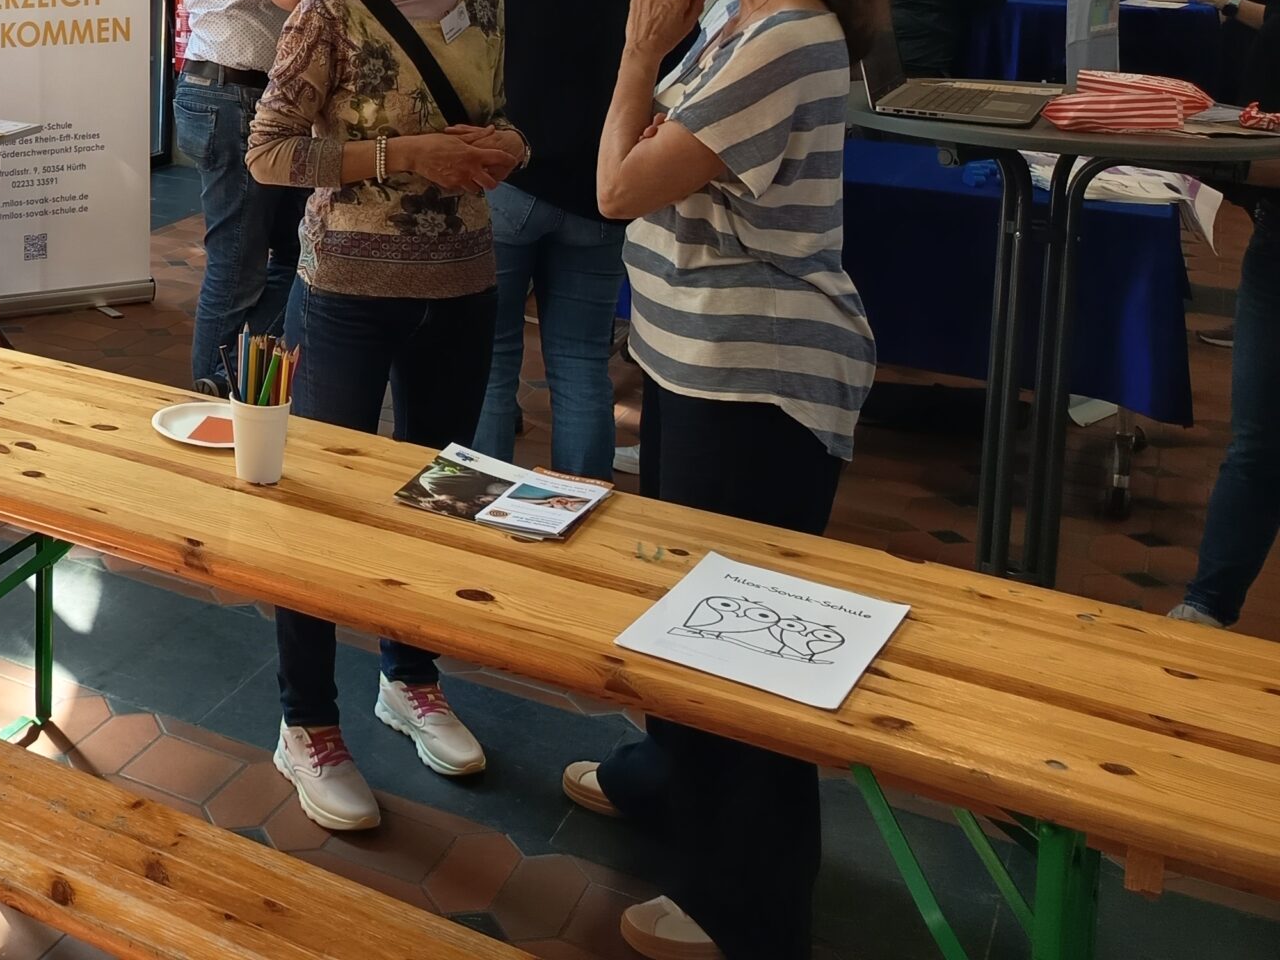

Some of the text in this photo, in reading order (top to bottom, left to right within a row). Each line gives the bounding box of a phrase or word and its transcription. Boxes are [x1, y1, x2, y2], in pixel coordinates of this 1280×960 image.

[18, 136, 33, 145] des
[34, 132, 100, 144] Rhein-Erft-Kreises
[74, 143, 105, 154] Sprache
[42, 164, 65, 174] 50354
[66, 162, 87, 172] Hürth
[11, 179, 35, 189] 02233
[723, 572, 873, 620] Milos-Sovak-Schule
